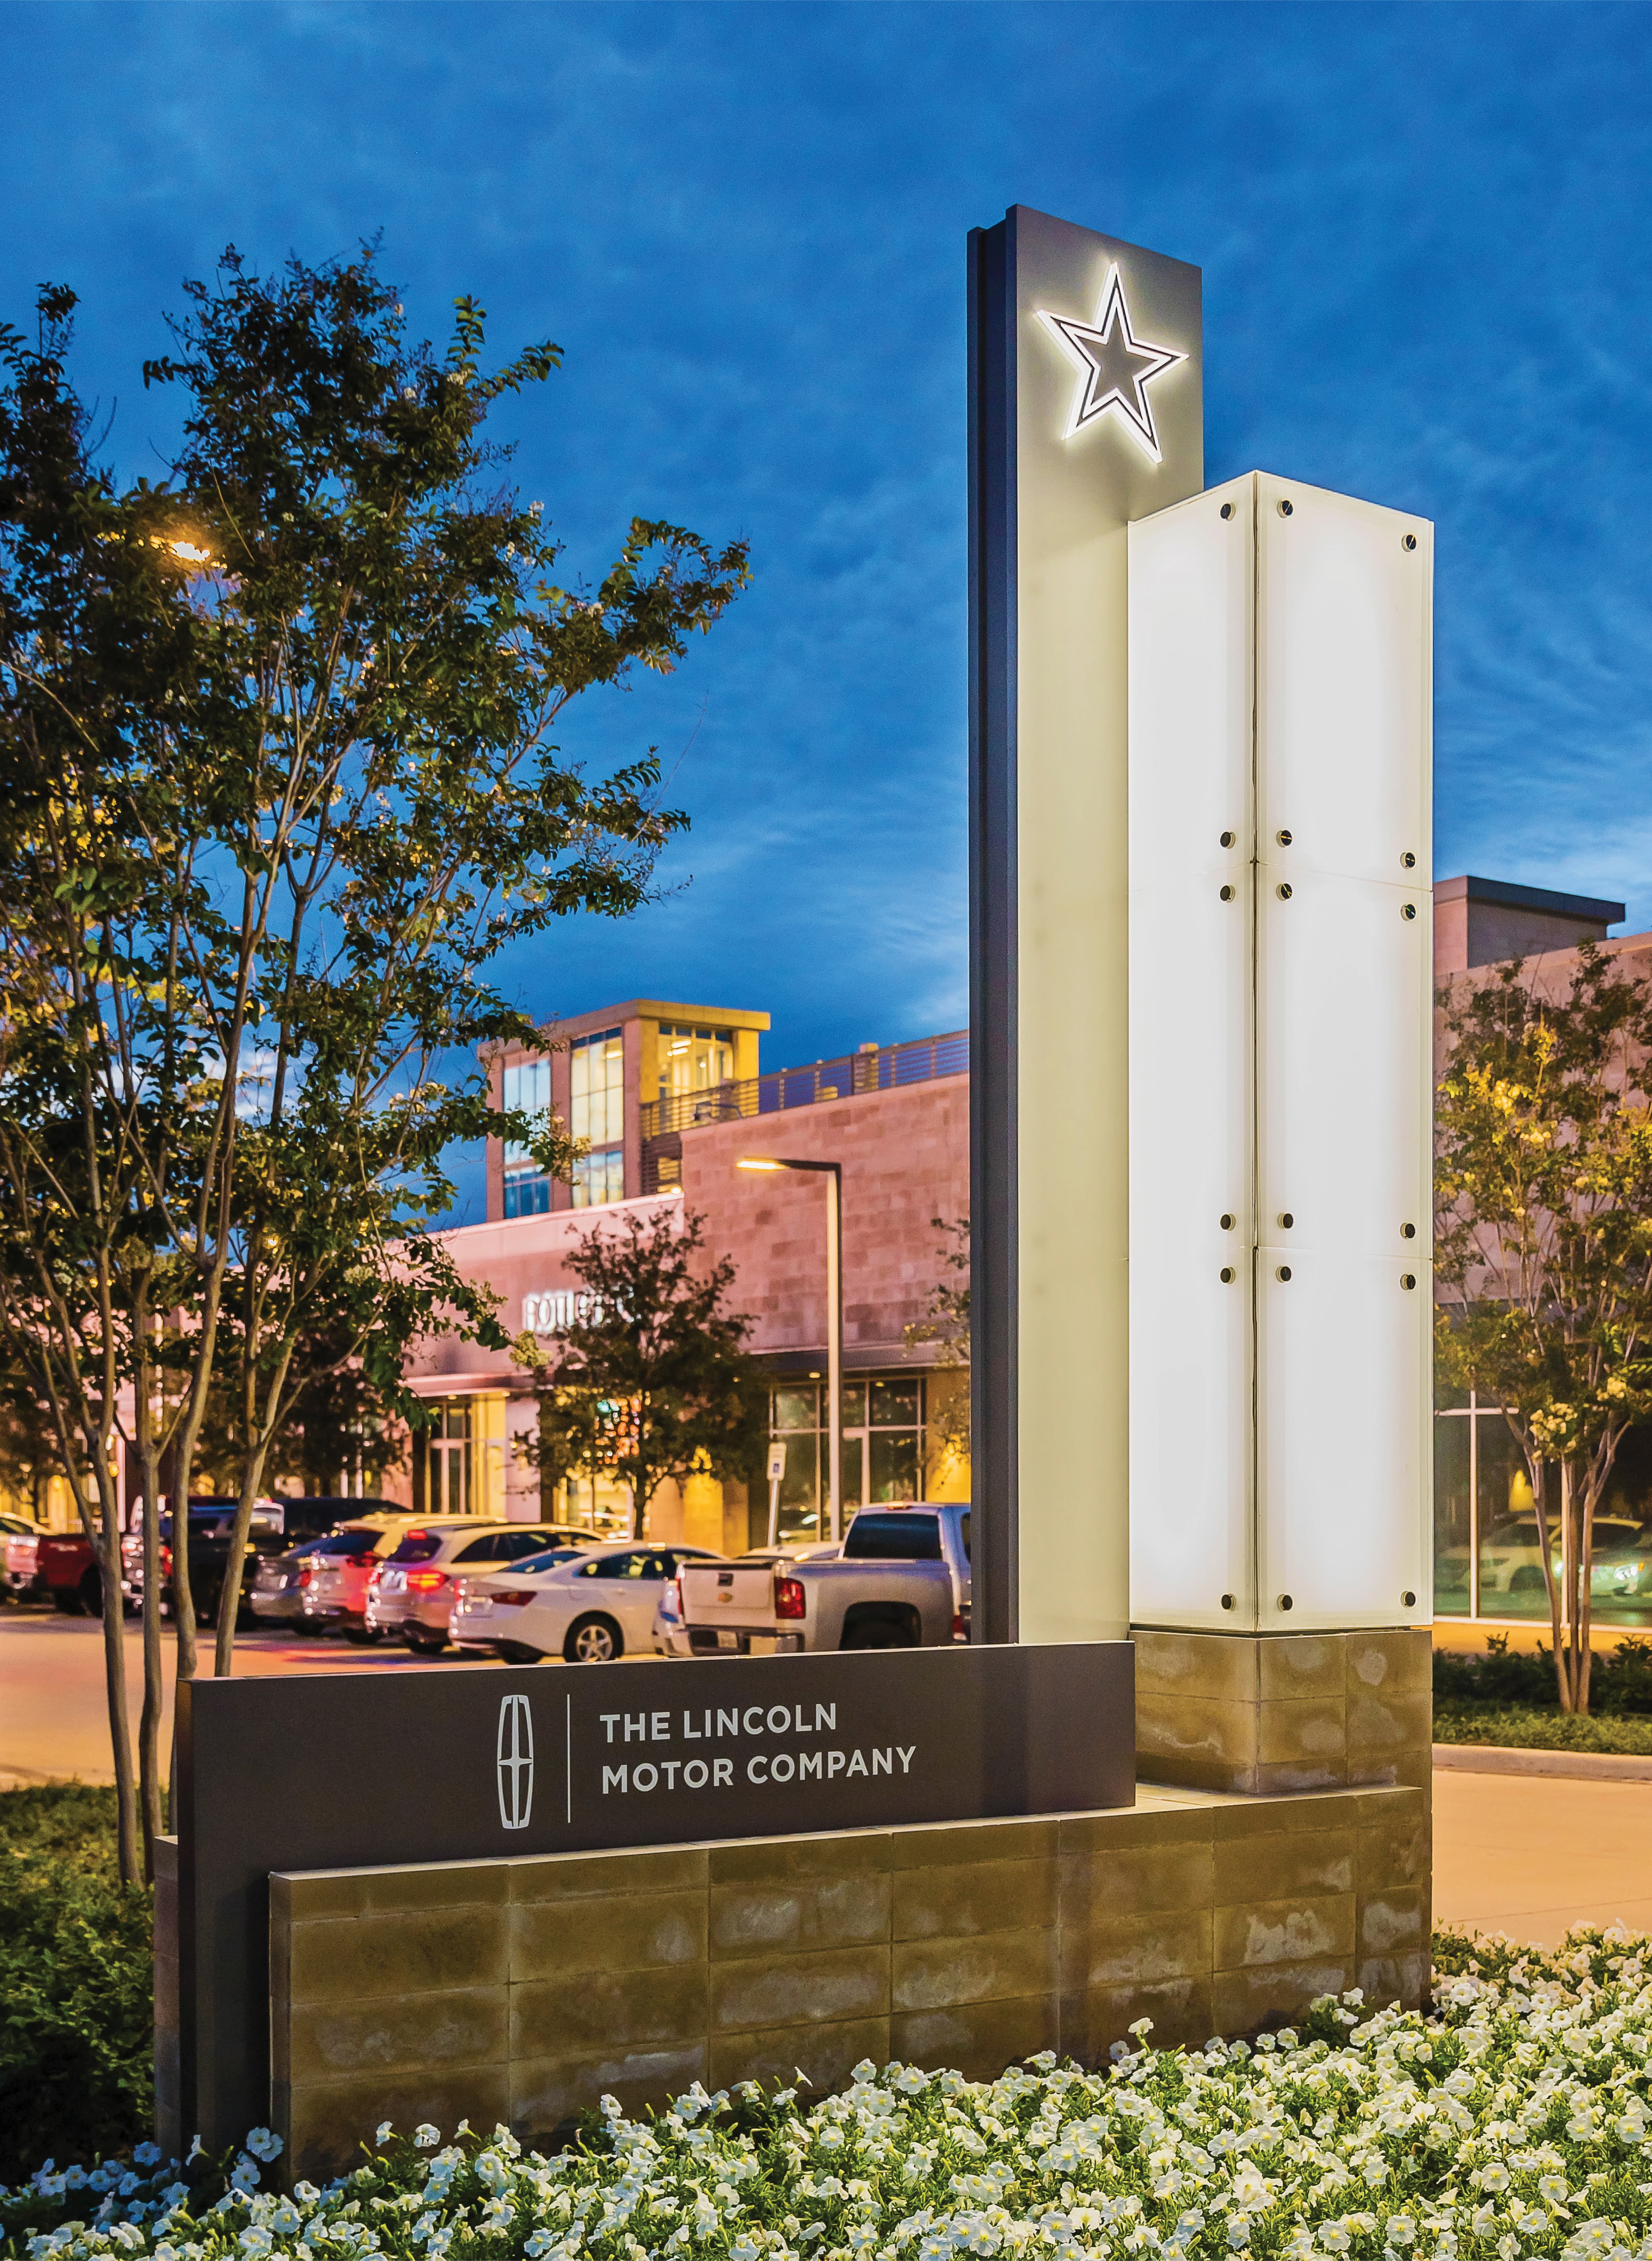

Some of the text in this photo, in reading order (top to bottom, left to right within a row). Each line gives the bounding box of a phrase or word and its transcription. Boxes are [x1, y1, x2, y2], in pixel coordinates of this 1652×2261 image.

[600, 1703, 836, 1743] THE LINCOLN
[603, 1746, 916, 1794] MOTOR COMPANY
